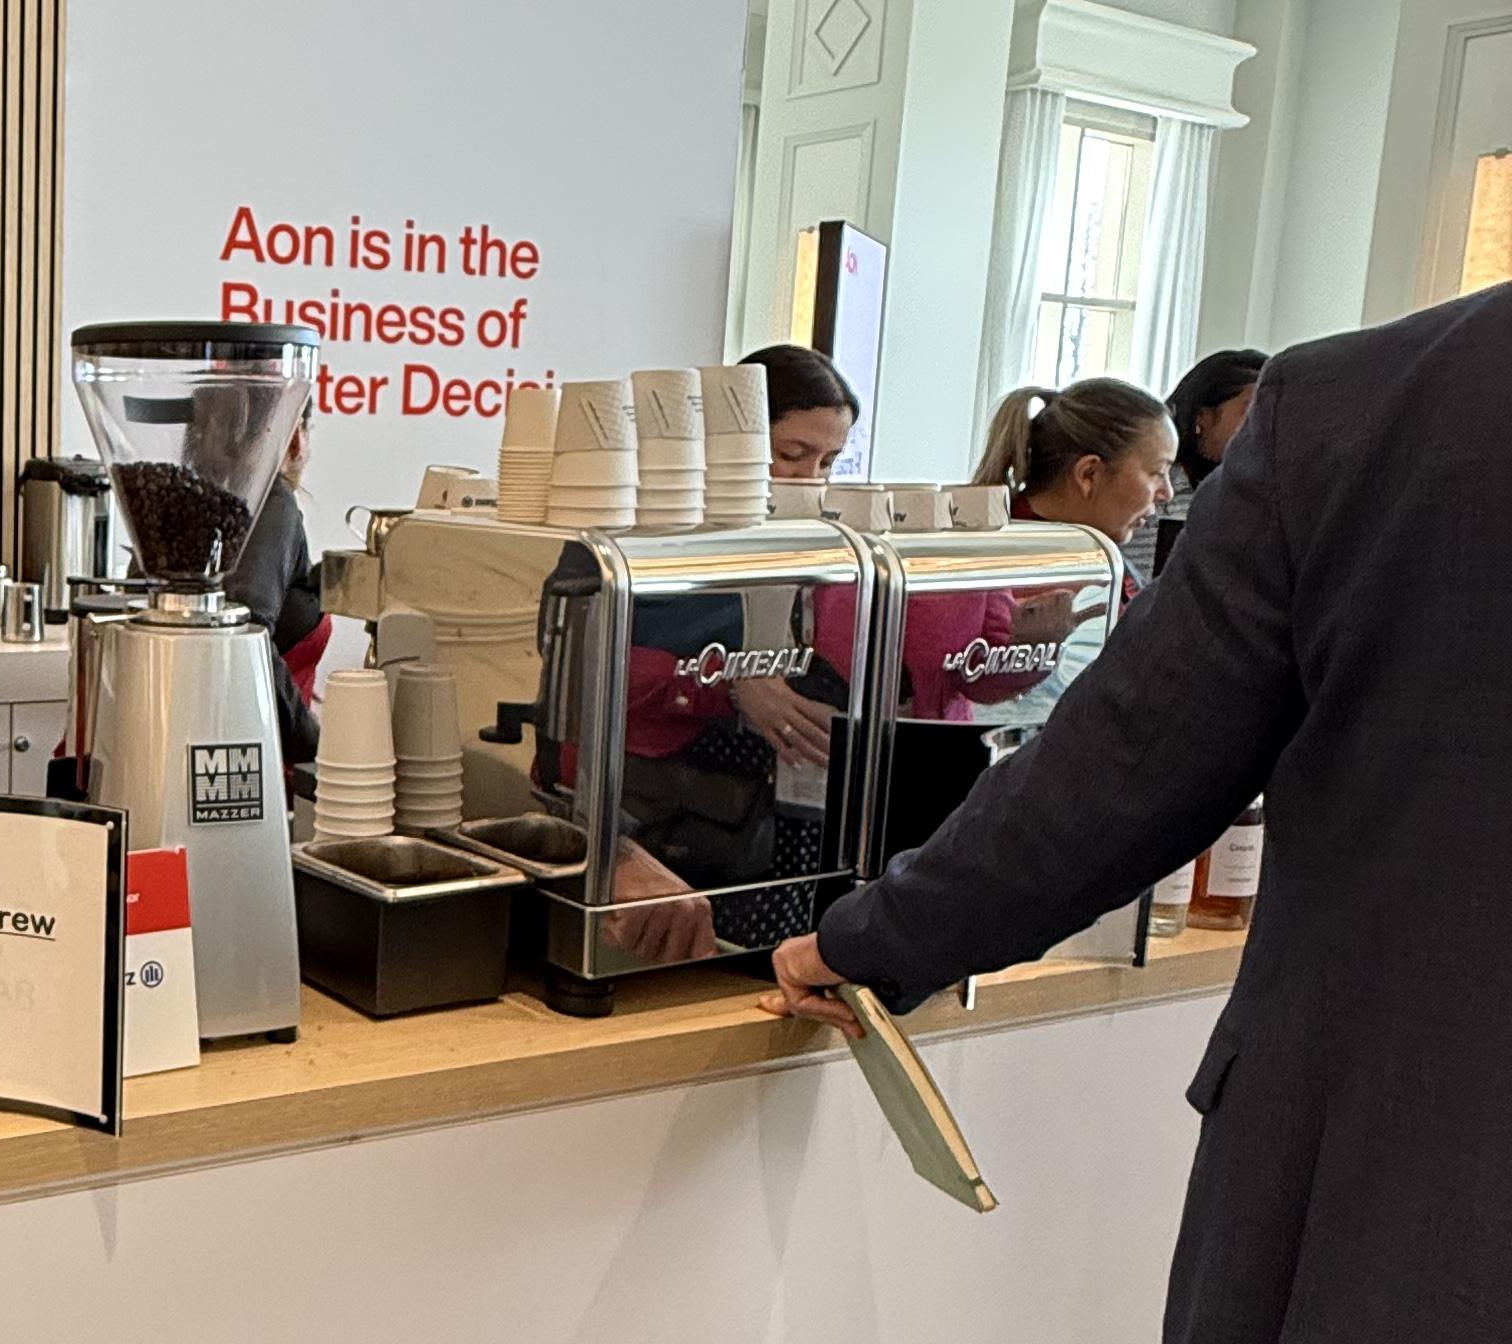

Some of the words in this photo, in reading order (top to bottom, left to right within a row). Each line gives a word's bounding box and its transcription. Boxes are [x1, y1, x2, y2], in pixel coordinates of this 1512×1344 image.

[221, 207, 335, 267] Aon
[350, 216, 391, 271] is
[404, 220, 447, 274] in
[459, 225, 540, 280] the
[221, 282, 465, 347] Business
[477, 298, 528, 348] of
[317, 365, 389, 416] ter
[196, 807, 260, 820] MAZZER
